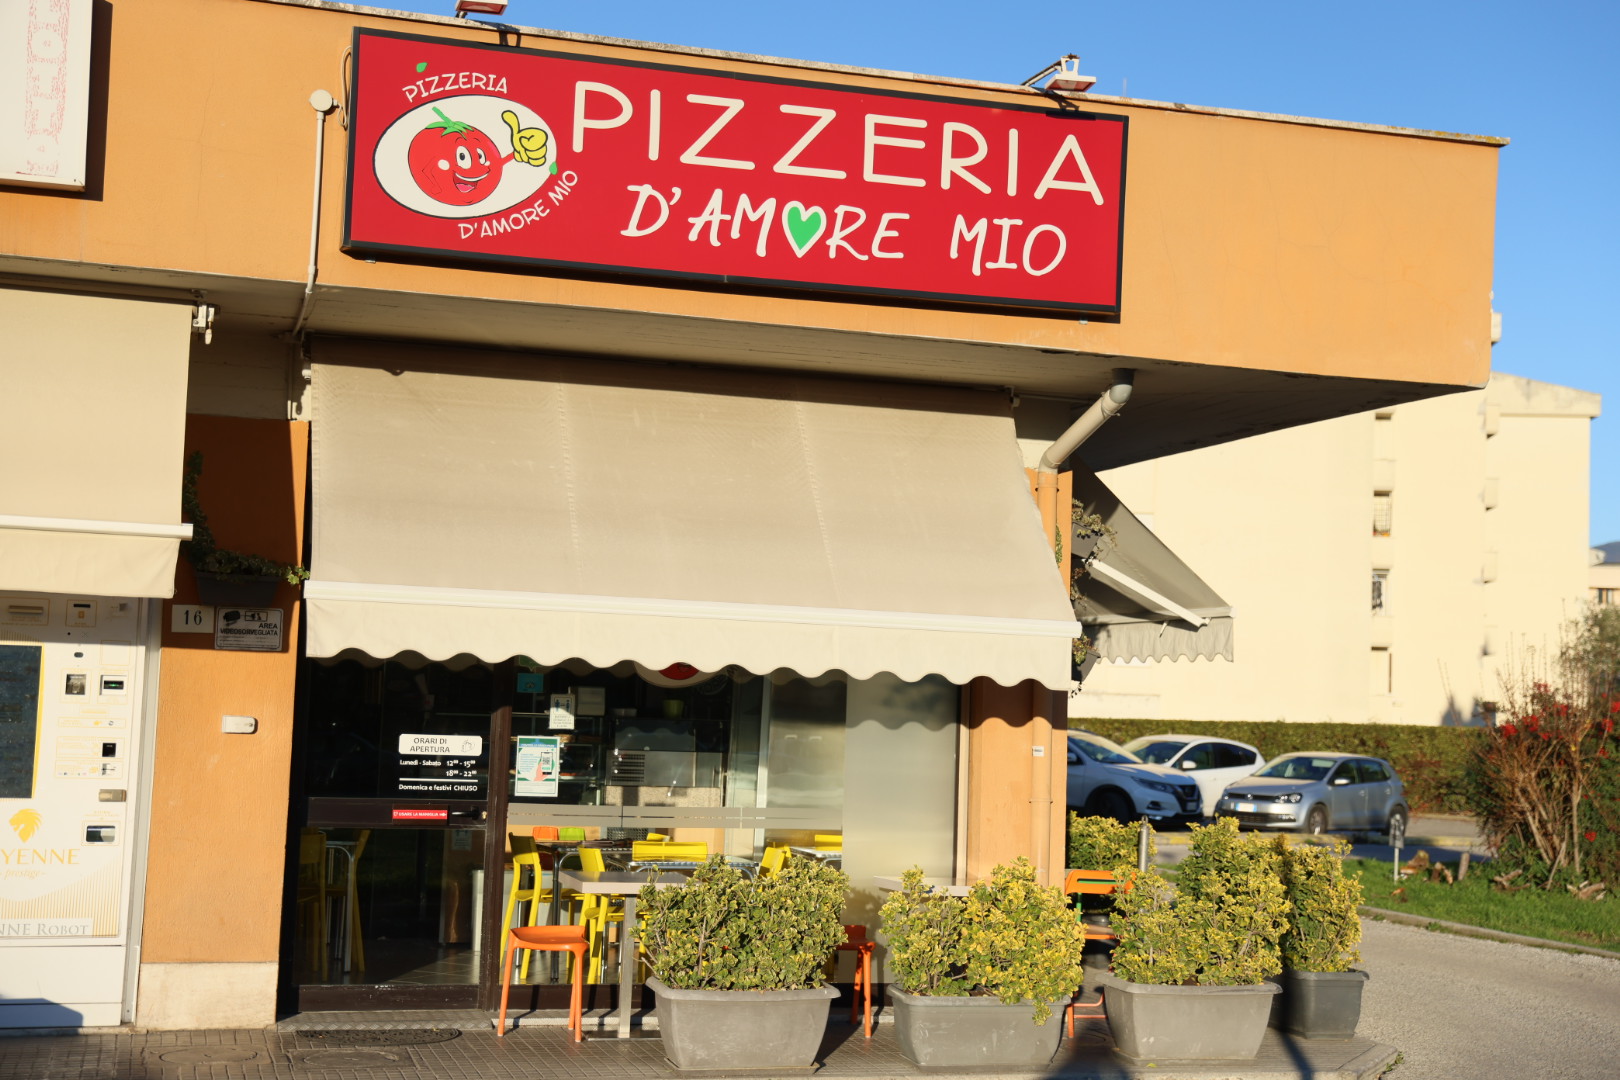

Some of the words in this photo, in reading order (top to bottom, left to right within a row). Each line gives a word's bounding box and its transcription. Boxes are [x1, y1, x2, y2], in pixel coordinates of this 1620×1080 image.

[402, 72, 508, 103] PIZZERIA
[572, 80, 1104, 206] PIZZERIA
[457, 199, 550, 240] D'AMORE
[547, 170, 578, 207] MIO
[949, 213, 1067, 277] MIO
[183, 609, 203, 626] 16
[220, 628, 278, 637] VIDEOSORVEGLIATA
[409, 745, 451, 753] APERTURA
[413, 737, 438, 745] ORARI
[398, 783, 428, 791] Domenica
[453, 784, 478, 792] CHIUSO
